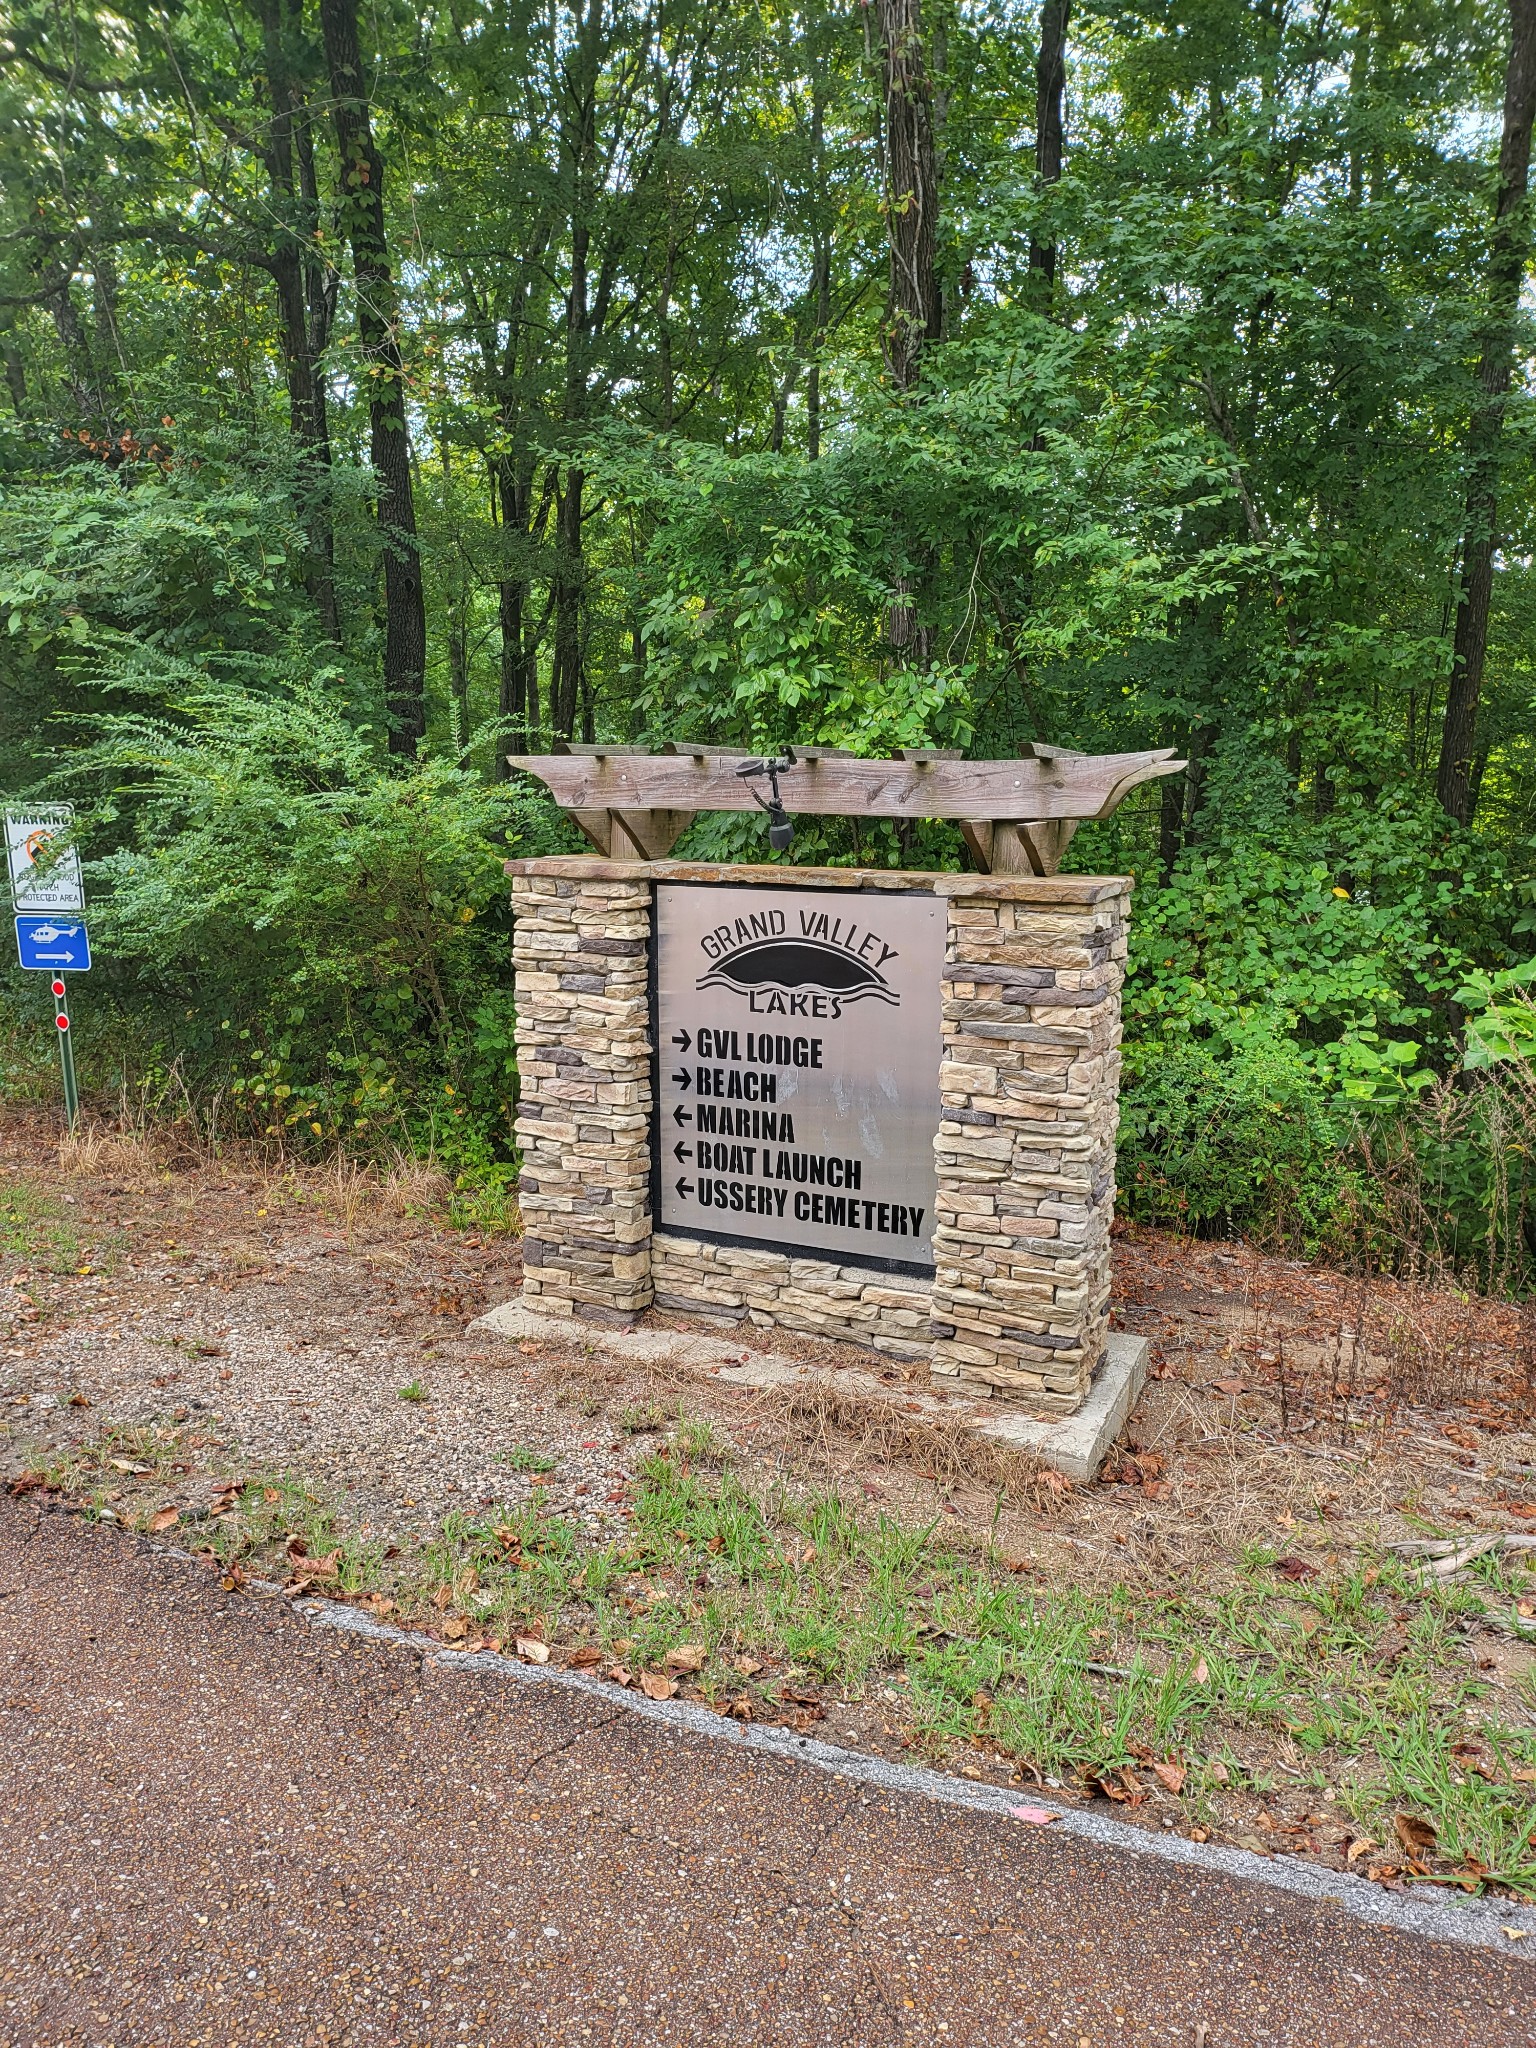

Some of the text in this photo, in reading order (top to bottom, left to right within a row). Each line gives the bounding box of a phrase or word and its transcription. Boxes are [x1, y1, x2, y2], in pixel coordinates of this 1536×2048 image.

[59, 894, 79, 903] AREA
[700, 909, 899, 968] GRAND VALLEY
[748, 990, 842, 1019] LAKES
[697, 1027, 823, 1069] GVL LODGE
[696, 1067, 777, 1103] BEACH
[696, 1104, 795, 1143] MARINA
[697, 1141, 862, 1190] BOAT LAUNCH
[698, 1178, 925, 1237] USSERY CEMETERY
